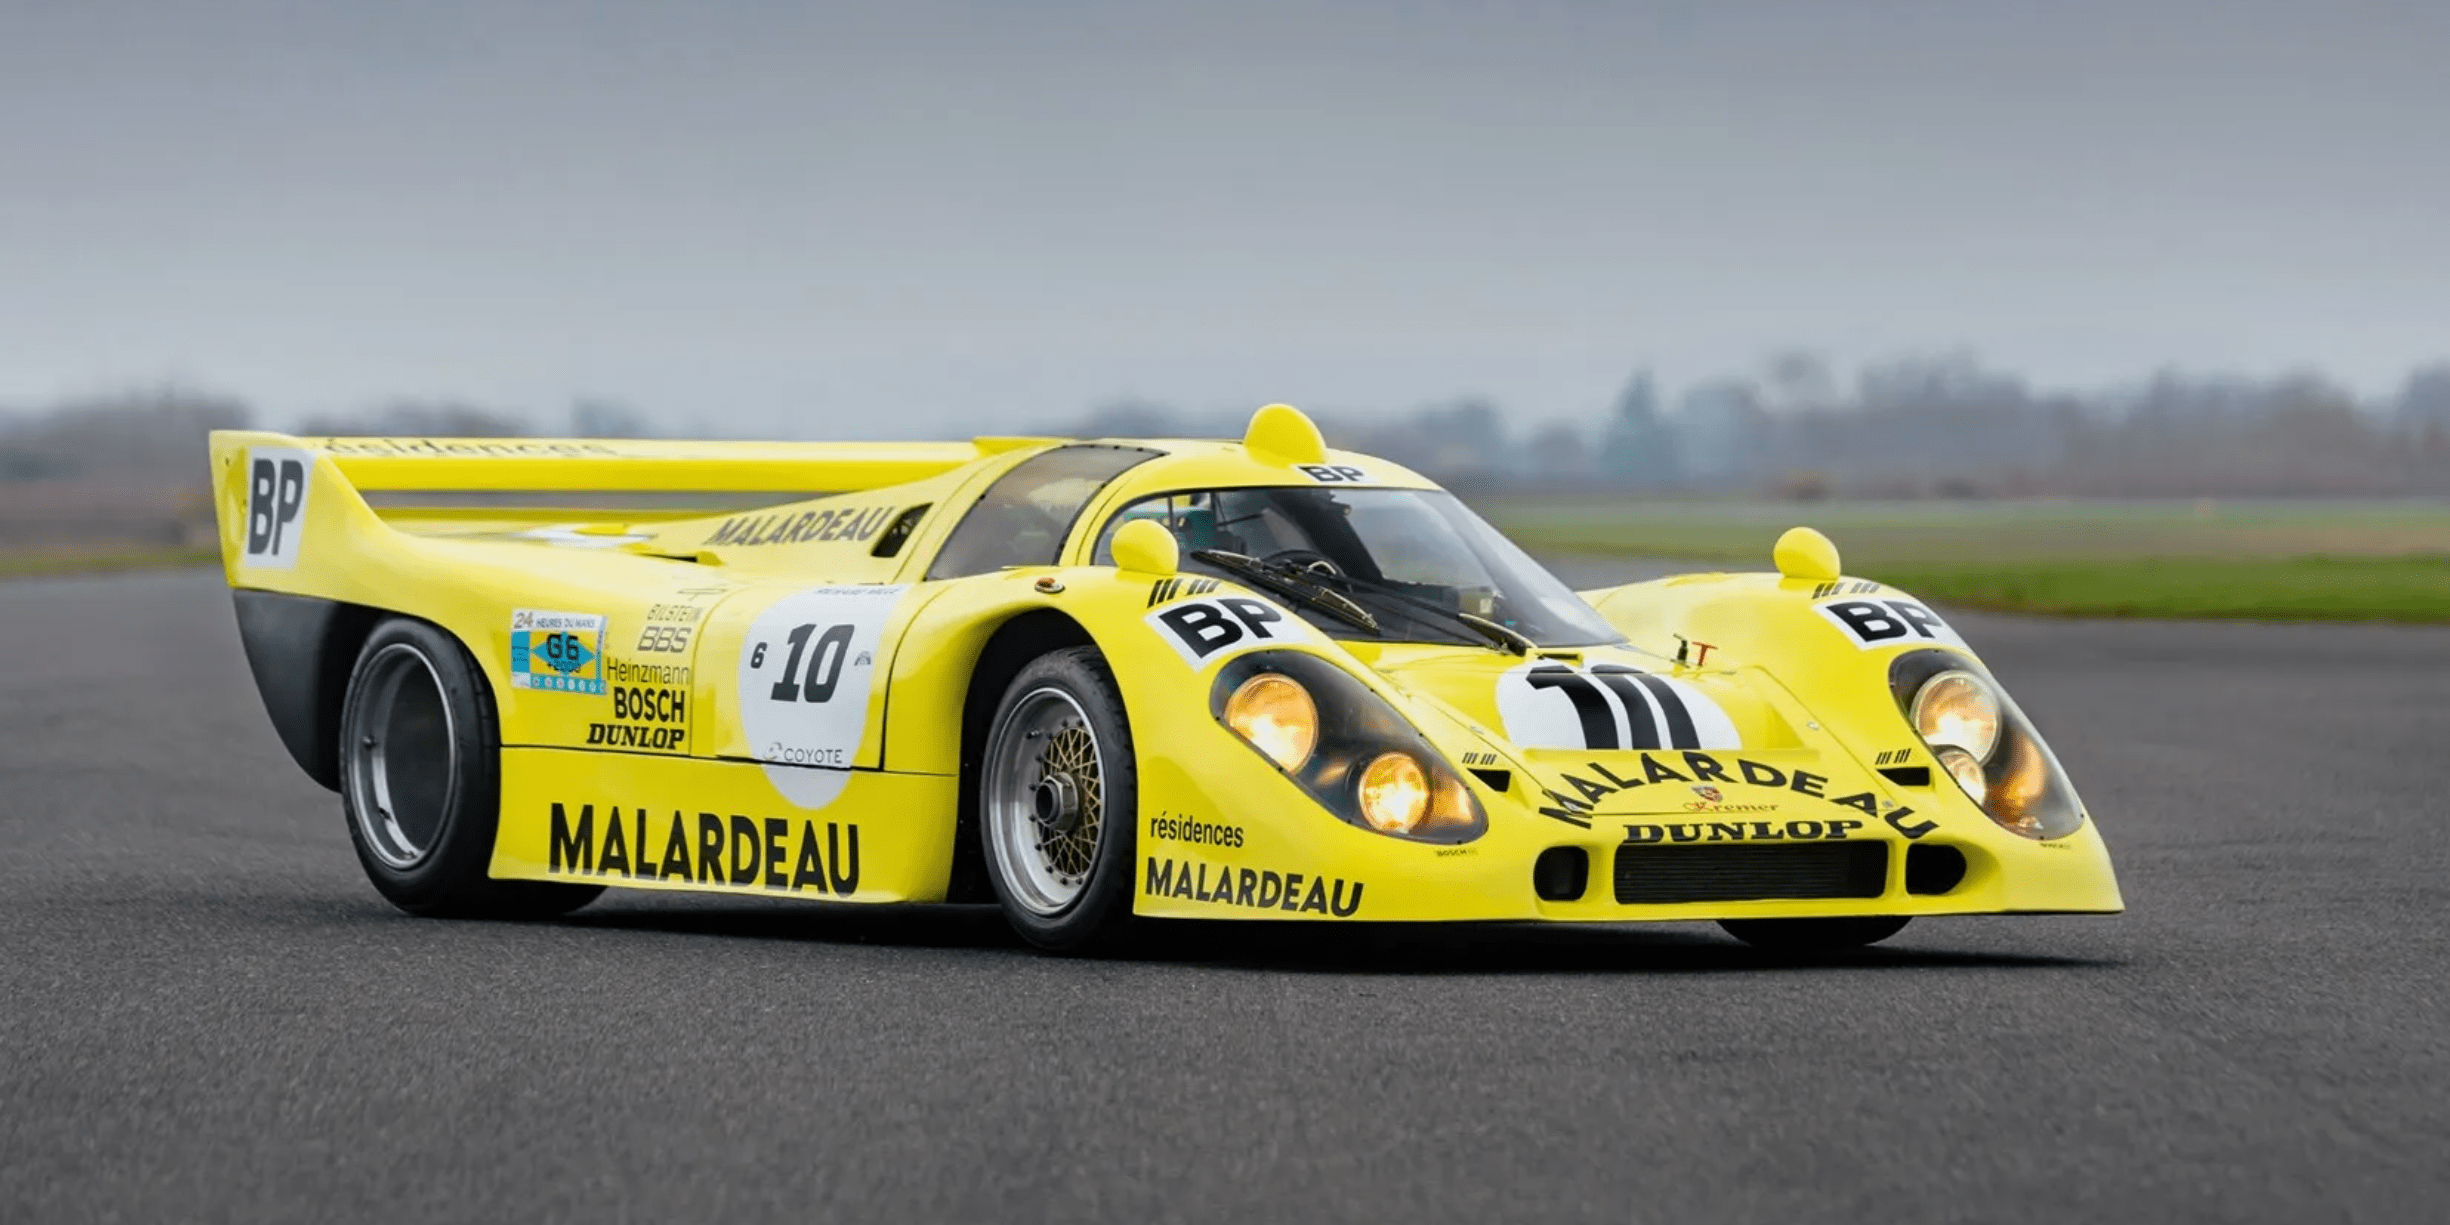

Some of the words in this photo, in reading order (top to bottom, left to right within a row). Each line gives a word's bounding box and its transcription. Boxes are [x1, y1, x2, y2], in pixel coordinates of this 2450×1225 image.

[1298, 465, 1364, 481] BP
[248, 458, 304, 556] BP
[702, 506, 895, 546] MALARDEAU
[513, 612, 533, 629] 24
[1160, 598, 1282, 660] BP
[1826, 600, 1943, 642] BP
[546, 633, 579, 661] G6
[638, 626, 692, 653] BBS
[751, 642, 767, 669] 6
[607, 657, 690, 685] Heinzmann
[771, 624, 855, 702] 10
[614, 687, 685, 723] BOSCH
[586, 723, 685, 749] DUNLOP
[784, 748, 842, 764] COYOTE
[1539, 751, 1939, 839] MALARDEAU
[1150, 811, 1244, 848] résidences
[1623, 819, 1864, 844] DUNLOP
[548, 802, 860, 900] MALARDEAU
[1145, 857, 1364, 918] MALARDEAU
